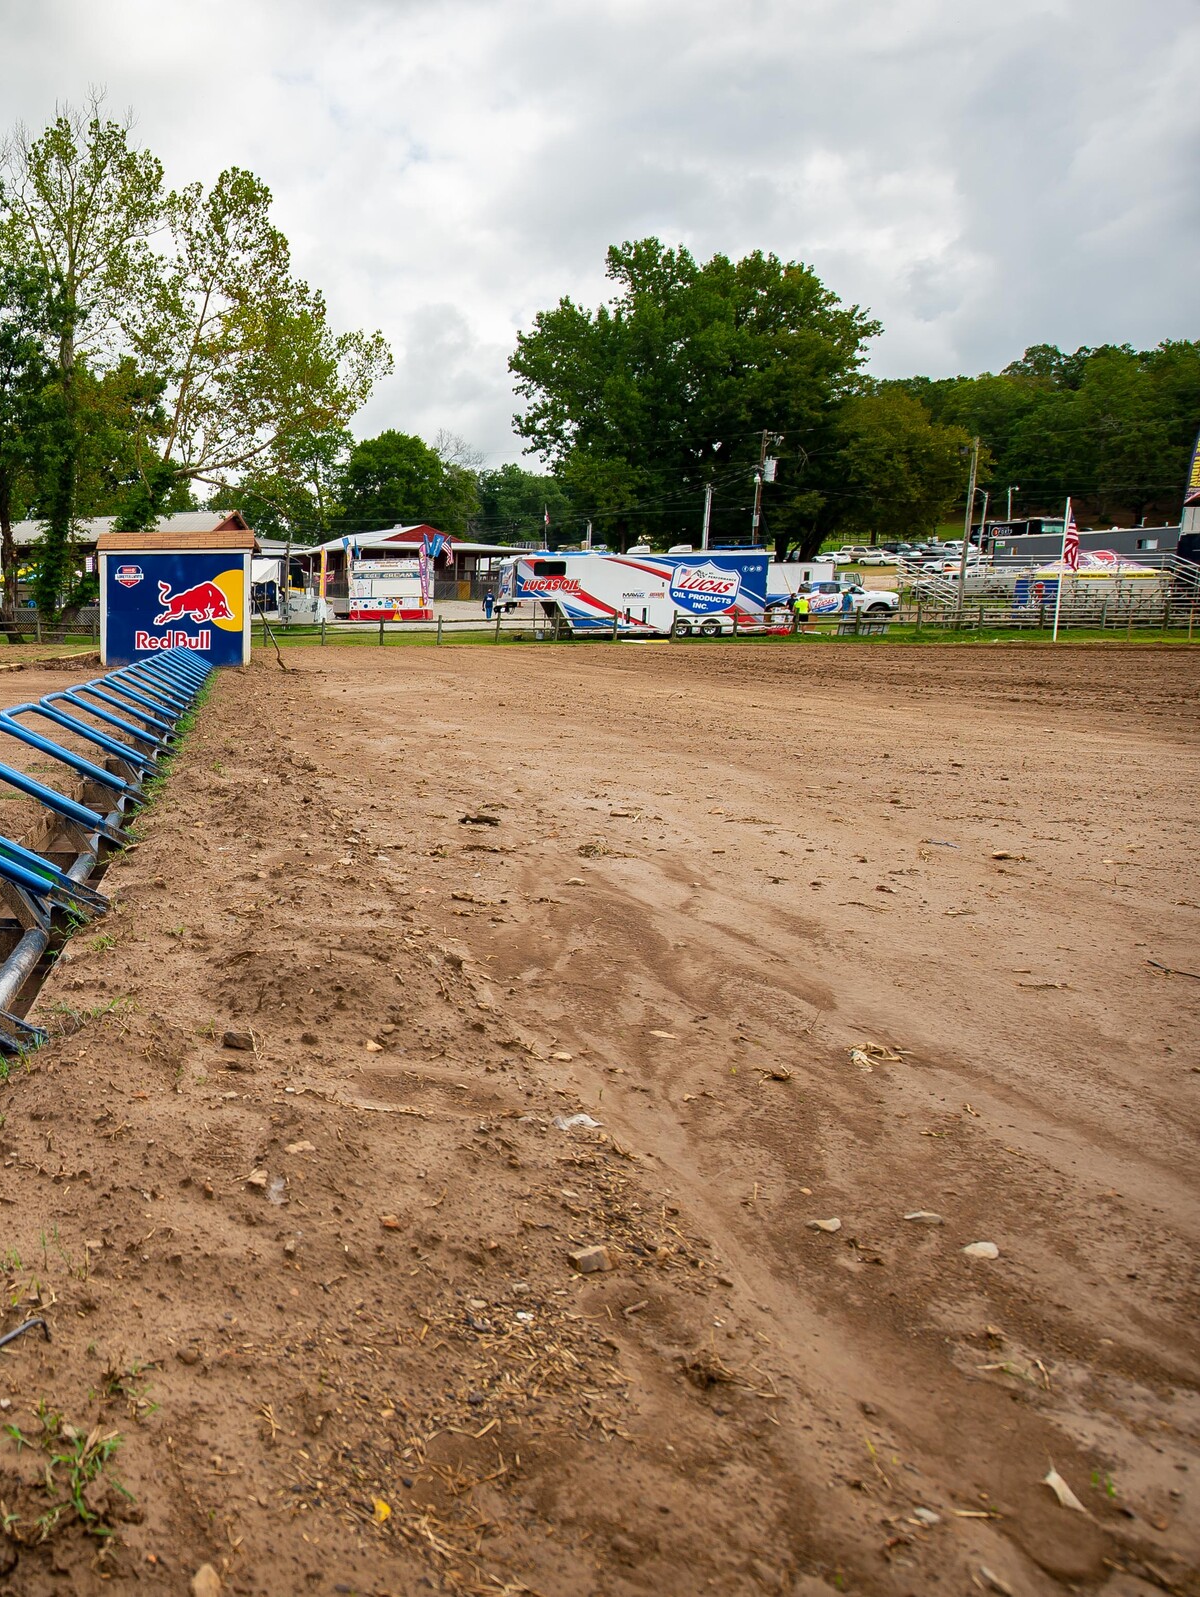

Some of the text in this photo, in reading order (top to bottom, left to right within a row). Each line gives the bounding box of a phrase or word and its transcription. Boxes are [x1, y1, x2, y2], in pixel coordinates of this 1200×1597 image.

[522, 579, 580, 591] LUCAS OIL
[677, 577, 734, 594] LUCAS
[672, 591, 686, 599] OIL
[688, 593, 732, 605] PRODUCTS
[692, 602, 709, 610] INC.
[135, 630, 211, 650] Red Bull
